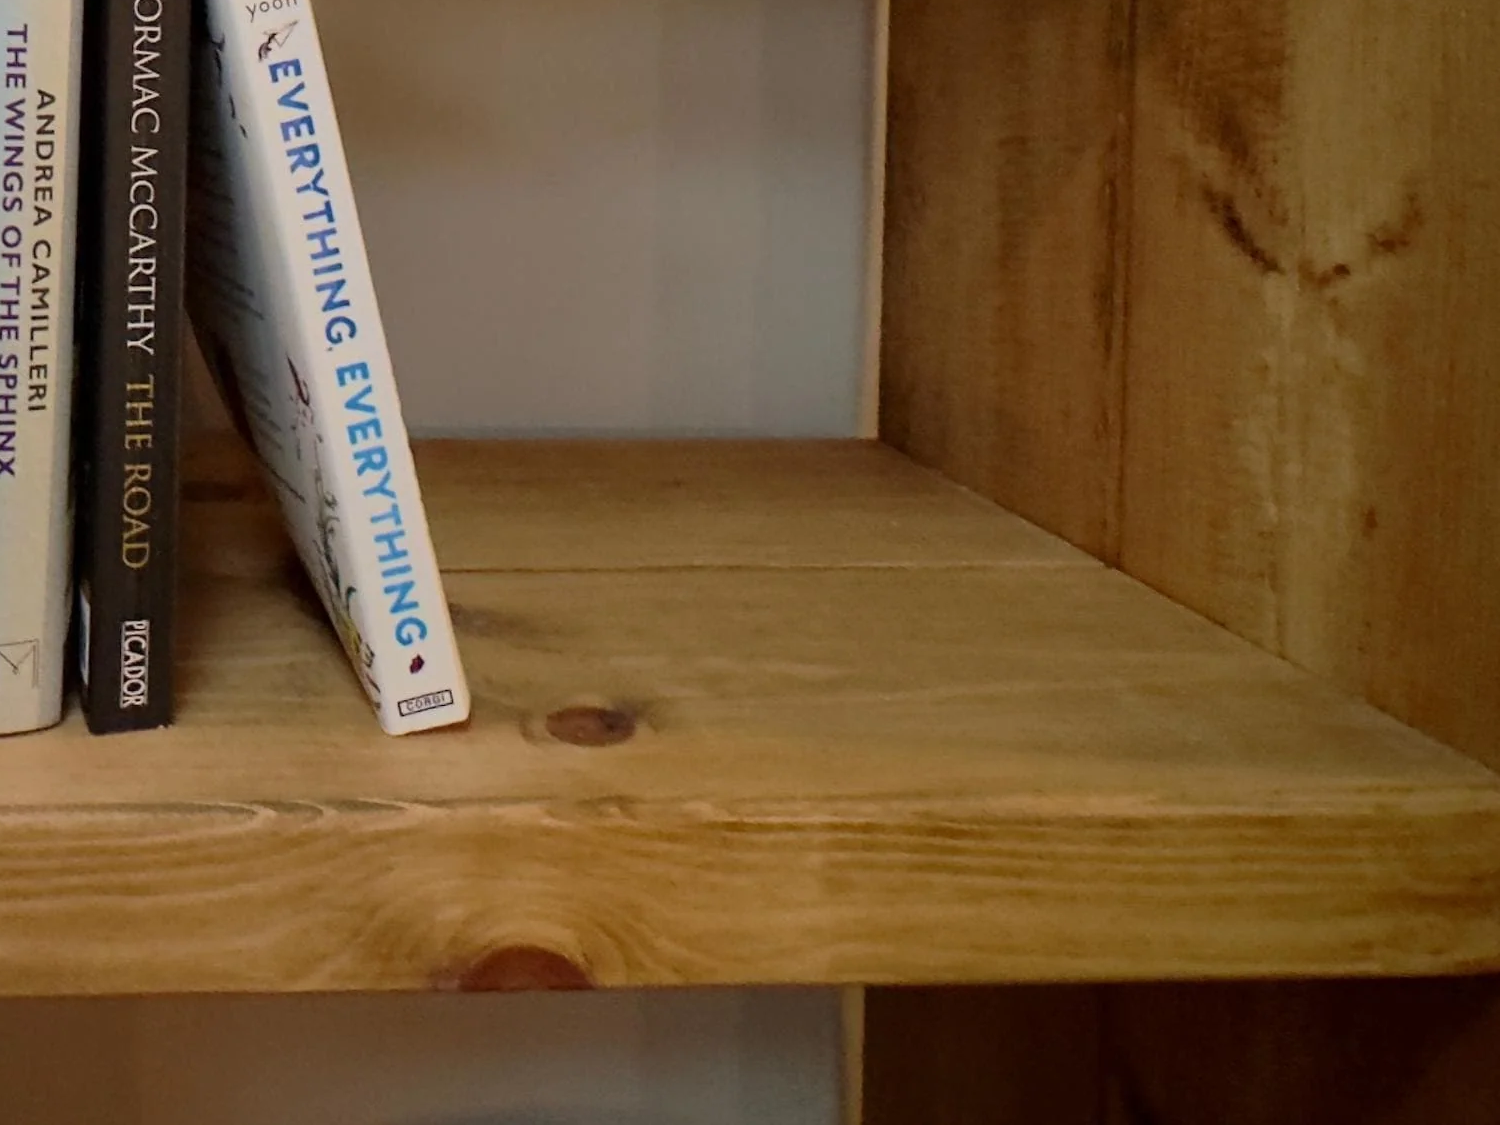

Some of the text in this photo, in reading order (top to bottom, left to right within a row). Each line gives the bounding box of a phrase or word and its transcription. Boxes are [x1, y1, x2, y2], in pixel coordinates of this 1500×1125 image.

[4, 23, 28, 89] THE
[0, 96, 27, 213] WINGS
[0, 224, 22, 267] OF
[26, 88, 57, 413] ANDREA CAMILLERI
[268, 58, 429, 647] EVERYTHING, EVERYTHING
[123, 374, 155, 450] THE
[122, 463, 153, 569] ROAD
[120, 619, 149, 709] PICADOR
[405, 693, 446, 712] CORGI
